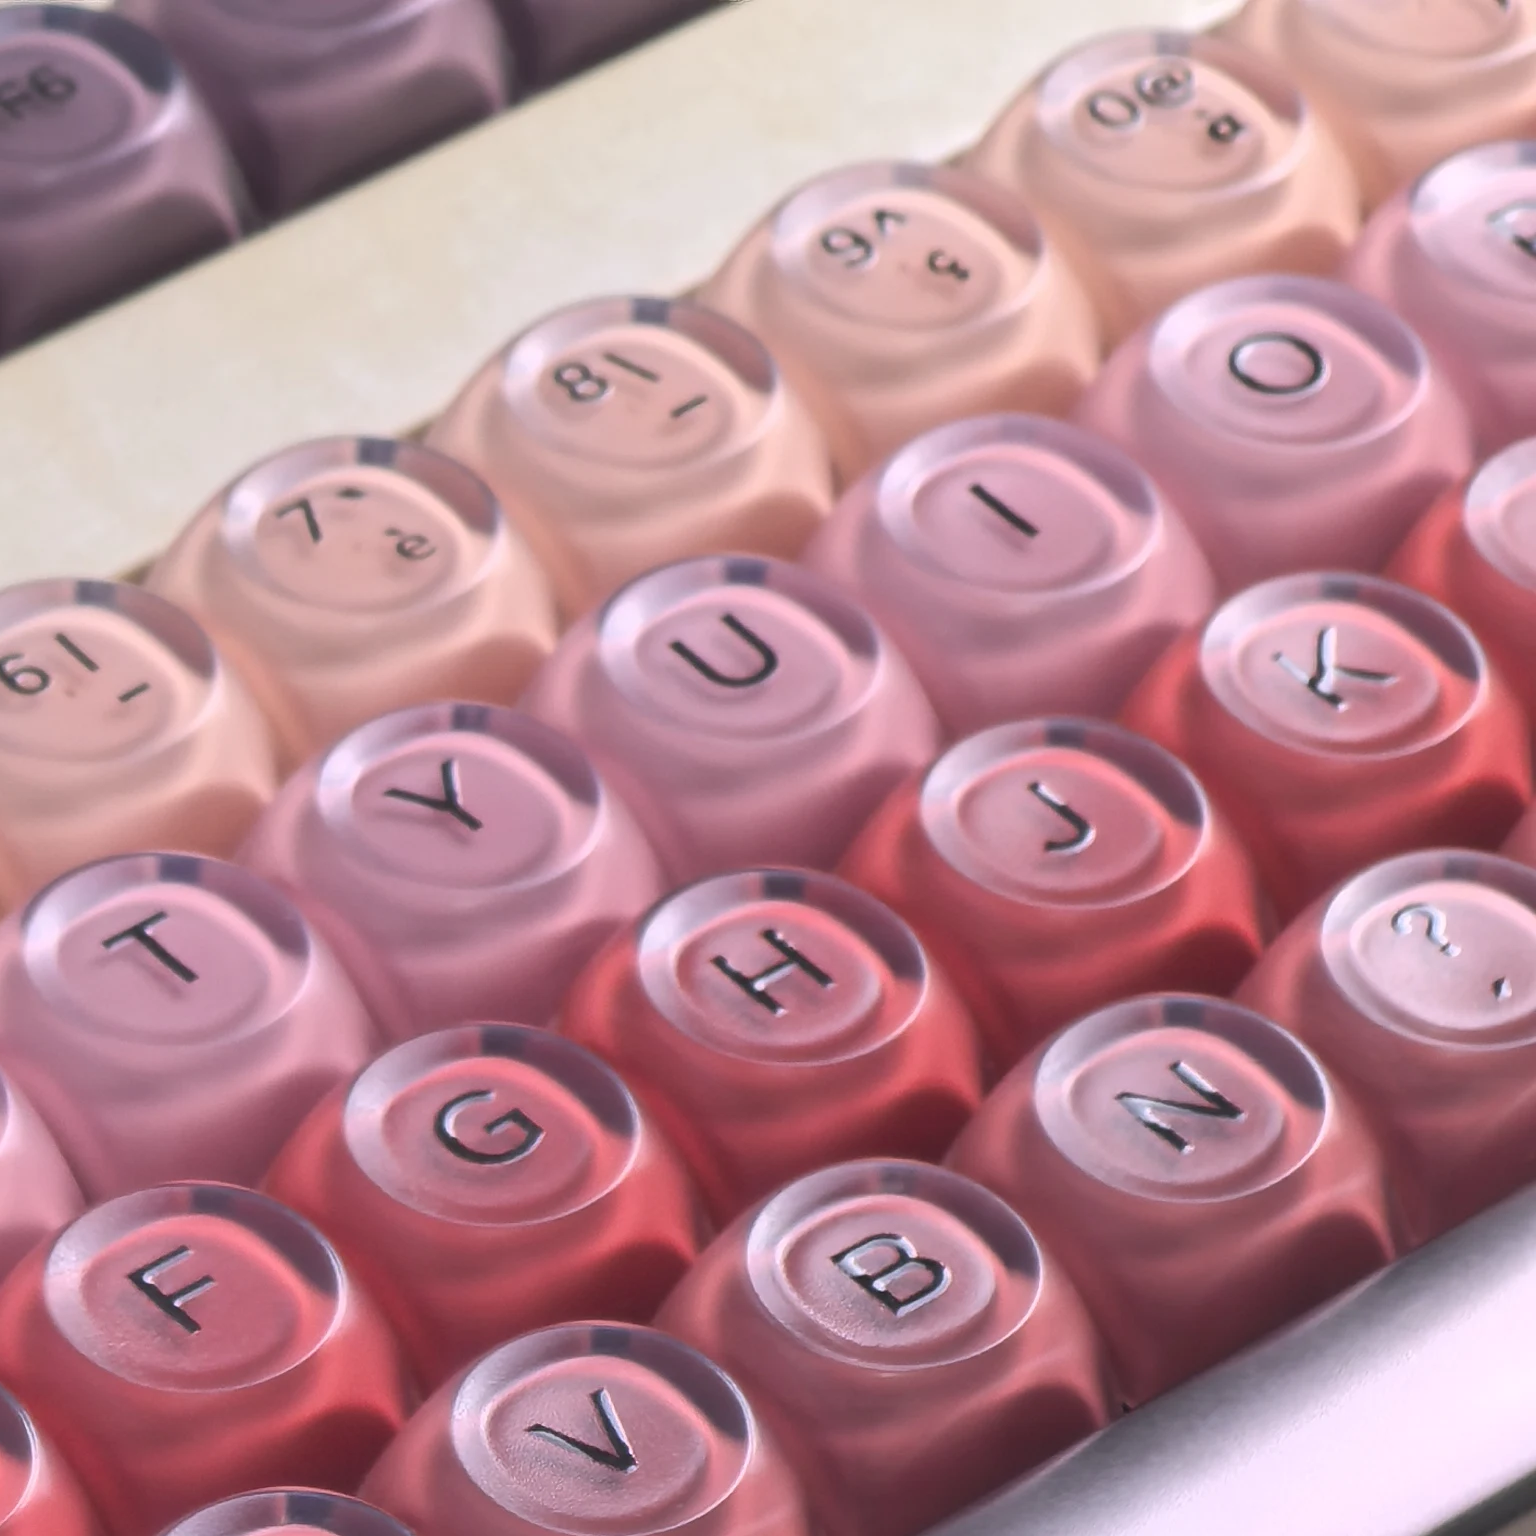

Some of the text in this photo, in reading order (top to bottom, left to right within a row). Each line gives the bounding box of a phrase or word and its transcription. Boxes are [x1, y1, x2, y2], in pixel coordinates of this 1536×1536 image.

[820, 226, 876, 270] 9
[554, 362, 608, 401] 8
[1228, 333, 1330, 396] O
[274, 499, 324, 544] 7
[669, 612, 779, 689] U
[1270, 626, 1400, 712] K
[382, 758, 484, 832] Y
[1026, 780, 1096, 856] J
[100, 910, 201, 984] T
[1390, 902, 1463, 958] ?
[709, 926, 835, 1018] H
[433, 1088, 547, 1166] G
[1115, 1060, 1247, 1156] N
[125, 1244, 219, 1335] F
[829, 1231, 952, 1319] B
[524, 1387, 640, 1474] V
